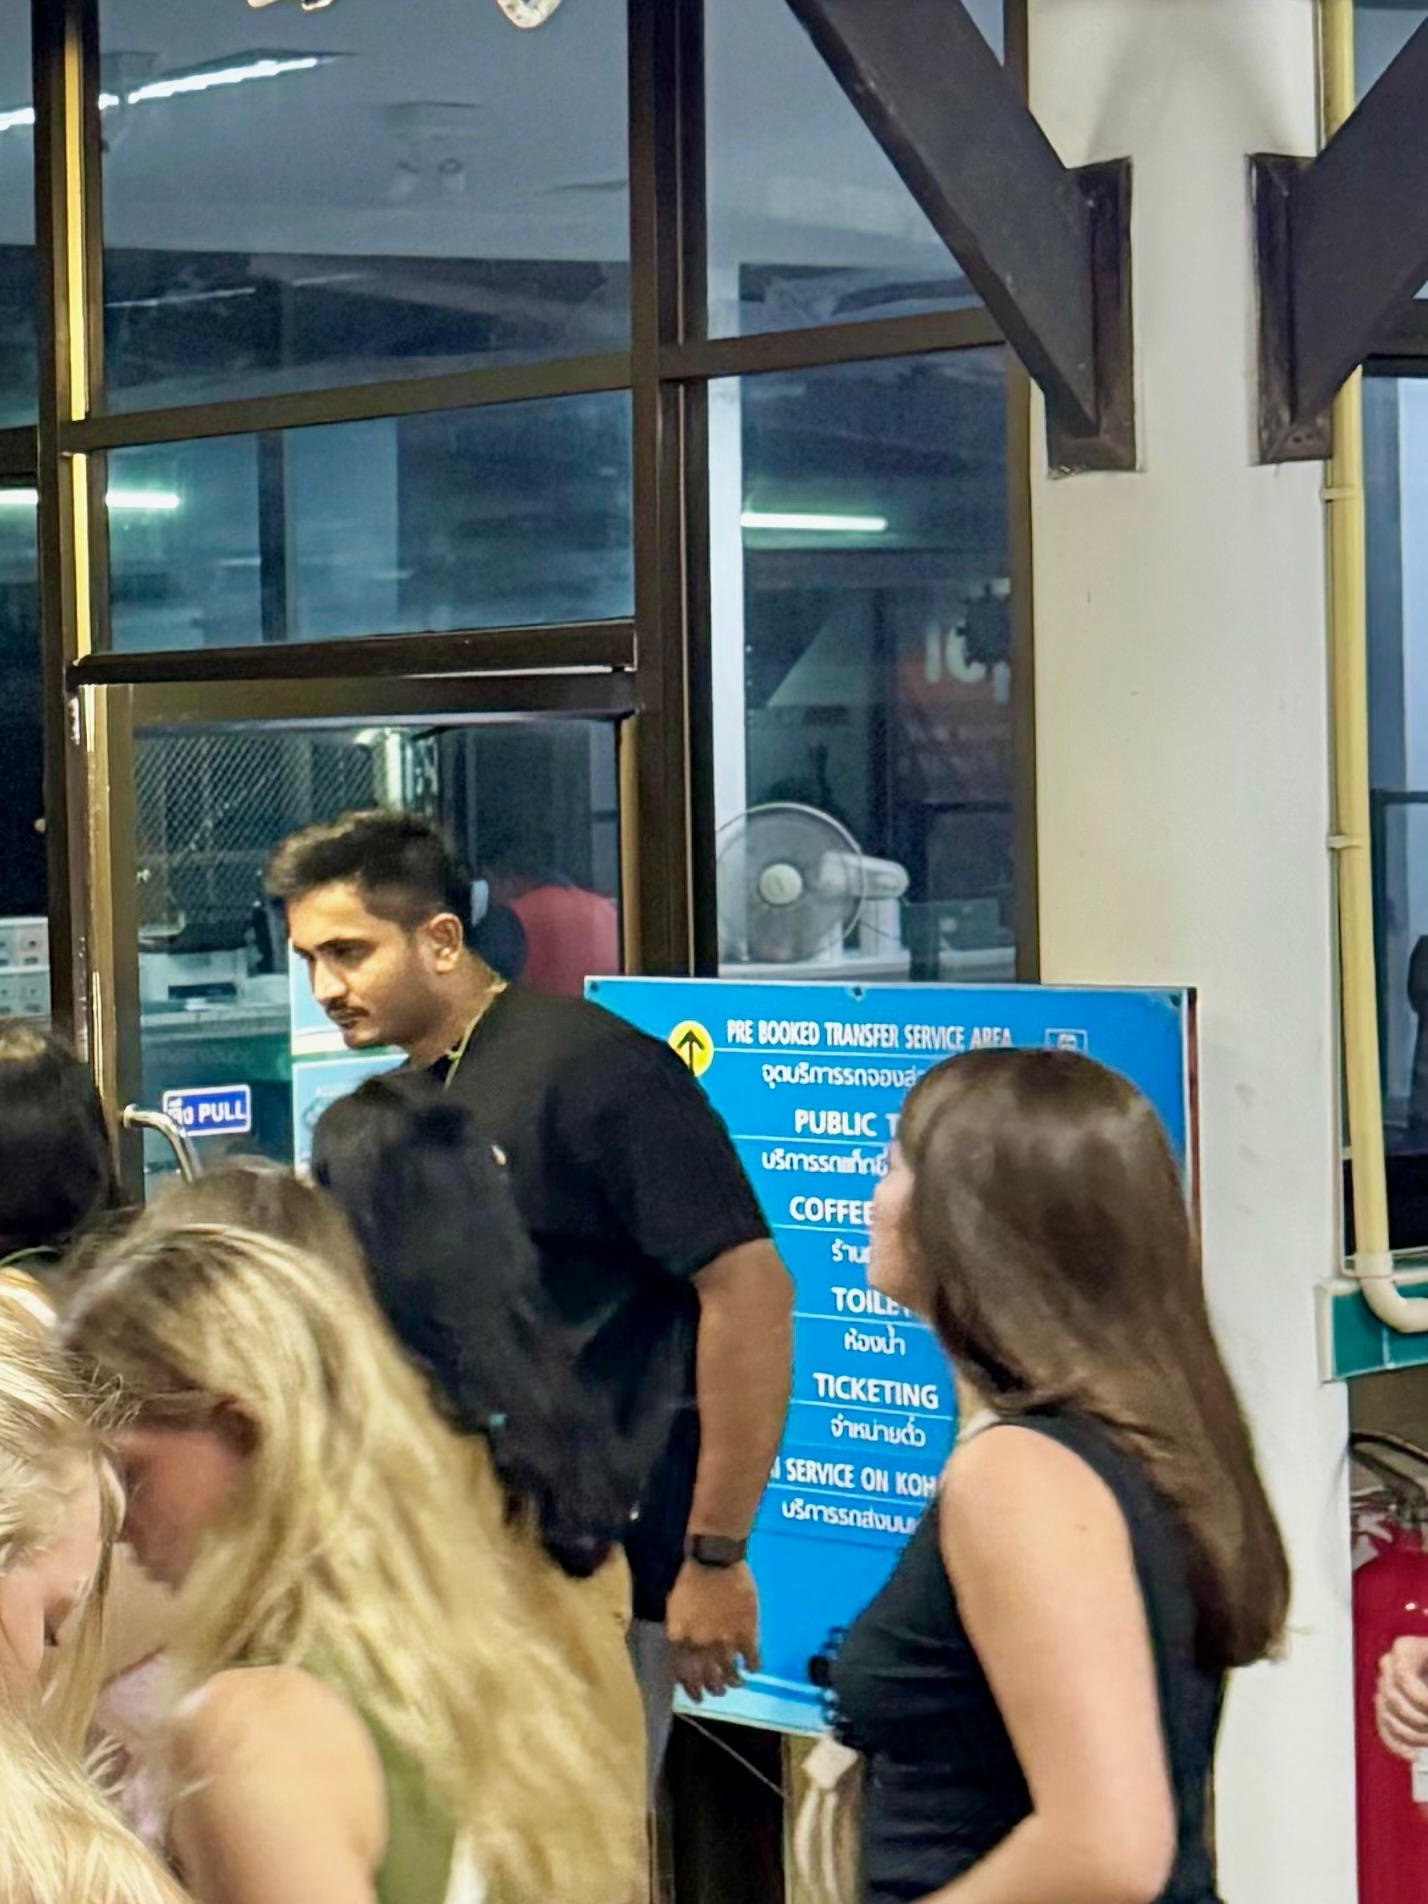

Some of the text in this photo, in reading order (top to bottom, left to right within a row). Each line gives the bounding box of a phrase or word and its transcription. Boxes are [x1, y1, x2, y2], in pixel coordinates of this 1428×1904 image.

[727, 1019, 1013, 1050] PRE BOOKED TRANSFER SERVICE AREA
[198, 1100, 246, 1124] PULL
[794, 1109, 878, 1138] PUBLIC
[789, 1196, 874, 1226] COFFEE
[811, 1371, 940, 1410] TICKETING
[785, 1456, 855, 1489] SERVICE
[860, 1466, 890, 1493] ON
[895, 1471, 937, 1498] KOH
